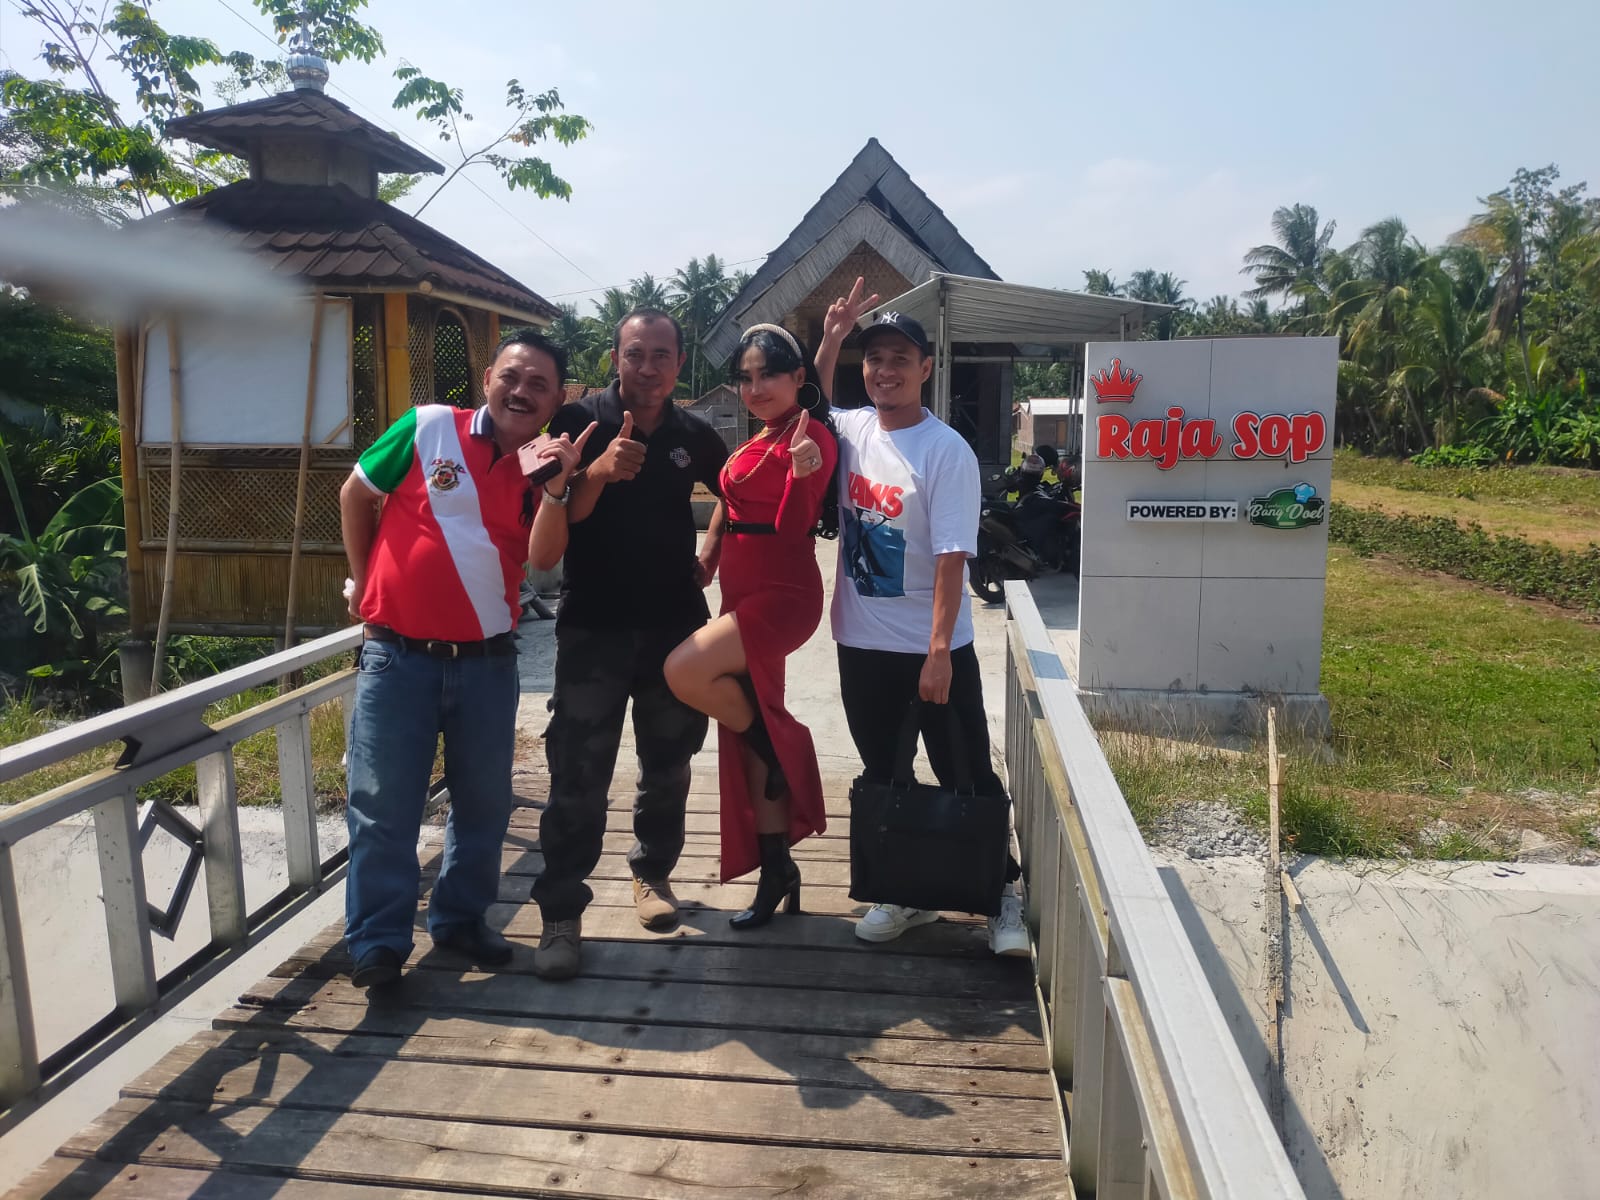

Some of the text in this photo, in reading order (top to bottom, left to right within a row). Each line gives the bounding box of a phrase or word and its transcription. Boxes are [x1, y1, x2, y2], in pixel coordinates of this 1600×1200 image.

[881, 311, 899, 324] NY
[1097, 407, 1222, 470] Raja
[849, 472, 904, 518] AWS
[1130, 505, 1236, 519] POWERED BY:
